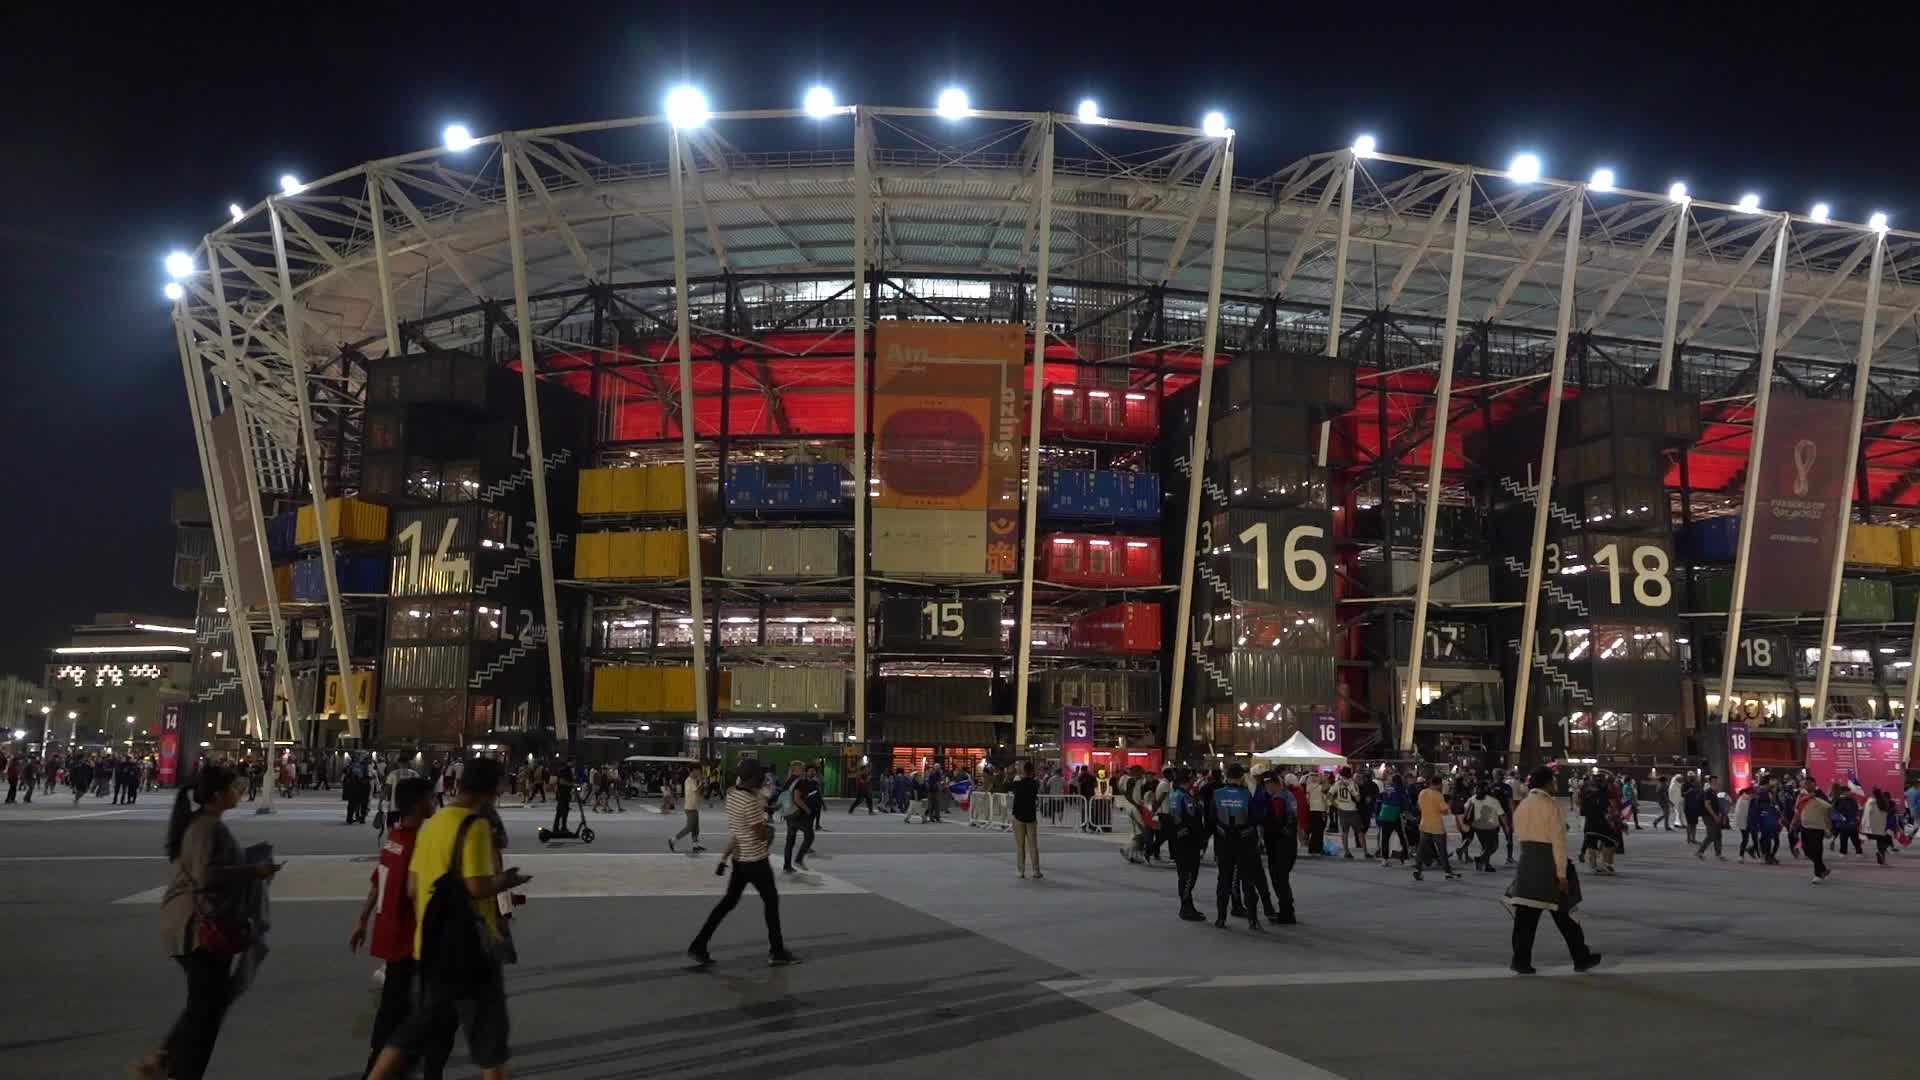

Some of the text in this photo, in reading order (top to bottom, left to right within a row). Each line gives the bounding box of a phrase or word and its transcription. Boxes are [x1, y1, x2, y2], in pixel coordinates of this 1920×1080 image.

[399, 518, 470, 586] 14
[1239, 522, 1327, 591] 16
[1593, 543, 1672, 607] 18
[501, 606, 534, 643] L2
[922, 602, 965, 637] 15
[1192, 613, 1214, 648] L2
[1426, 626, 1458, 659] 17
[1534, 628, 1565, 661] L2
[1740, 638, 1772, 667] 18
[165, 713, 178, 730] 14
[495, 699, 528, 733] L1
[1068, 719, 1087, 738] 15
[1192, 707, 1215, 741] L1
[1538, 715, 1569, 748] L1
[1319, 724, 1336, 742] 16
[1731, 734, 1747, 750] 18
